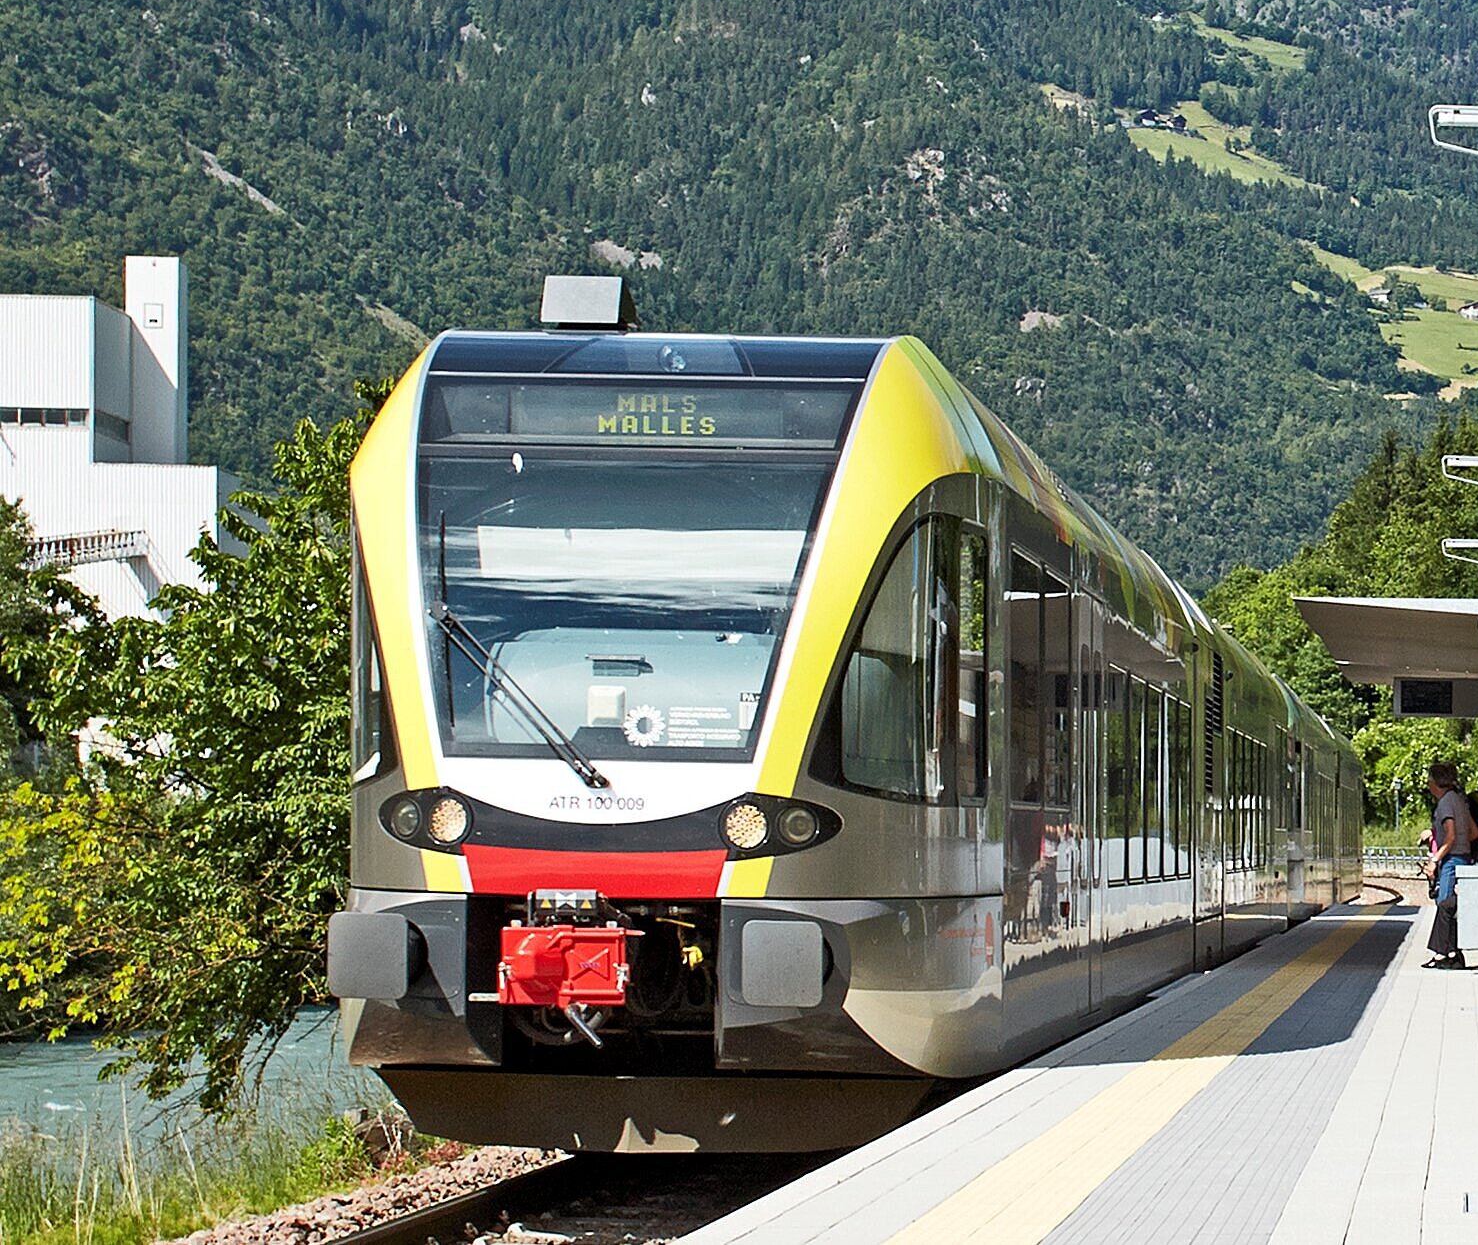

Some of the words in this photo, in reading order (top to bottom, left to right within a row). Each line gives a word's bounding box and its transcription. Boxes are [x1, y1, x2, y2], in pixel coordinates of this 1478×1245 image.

[617, 394, 697, 413] MALS
[598, 415, 716, 435] MALLES
[549, 796, 580, 809] ATR
[588, 796, 613, 810] 100
[617, 797, 645, 811] 009
